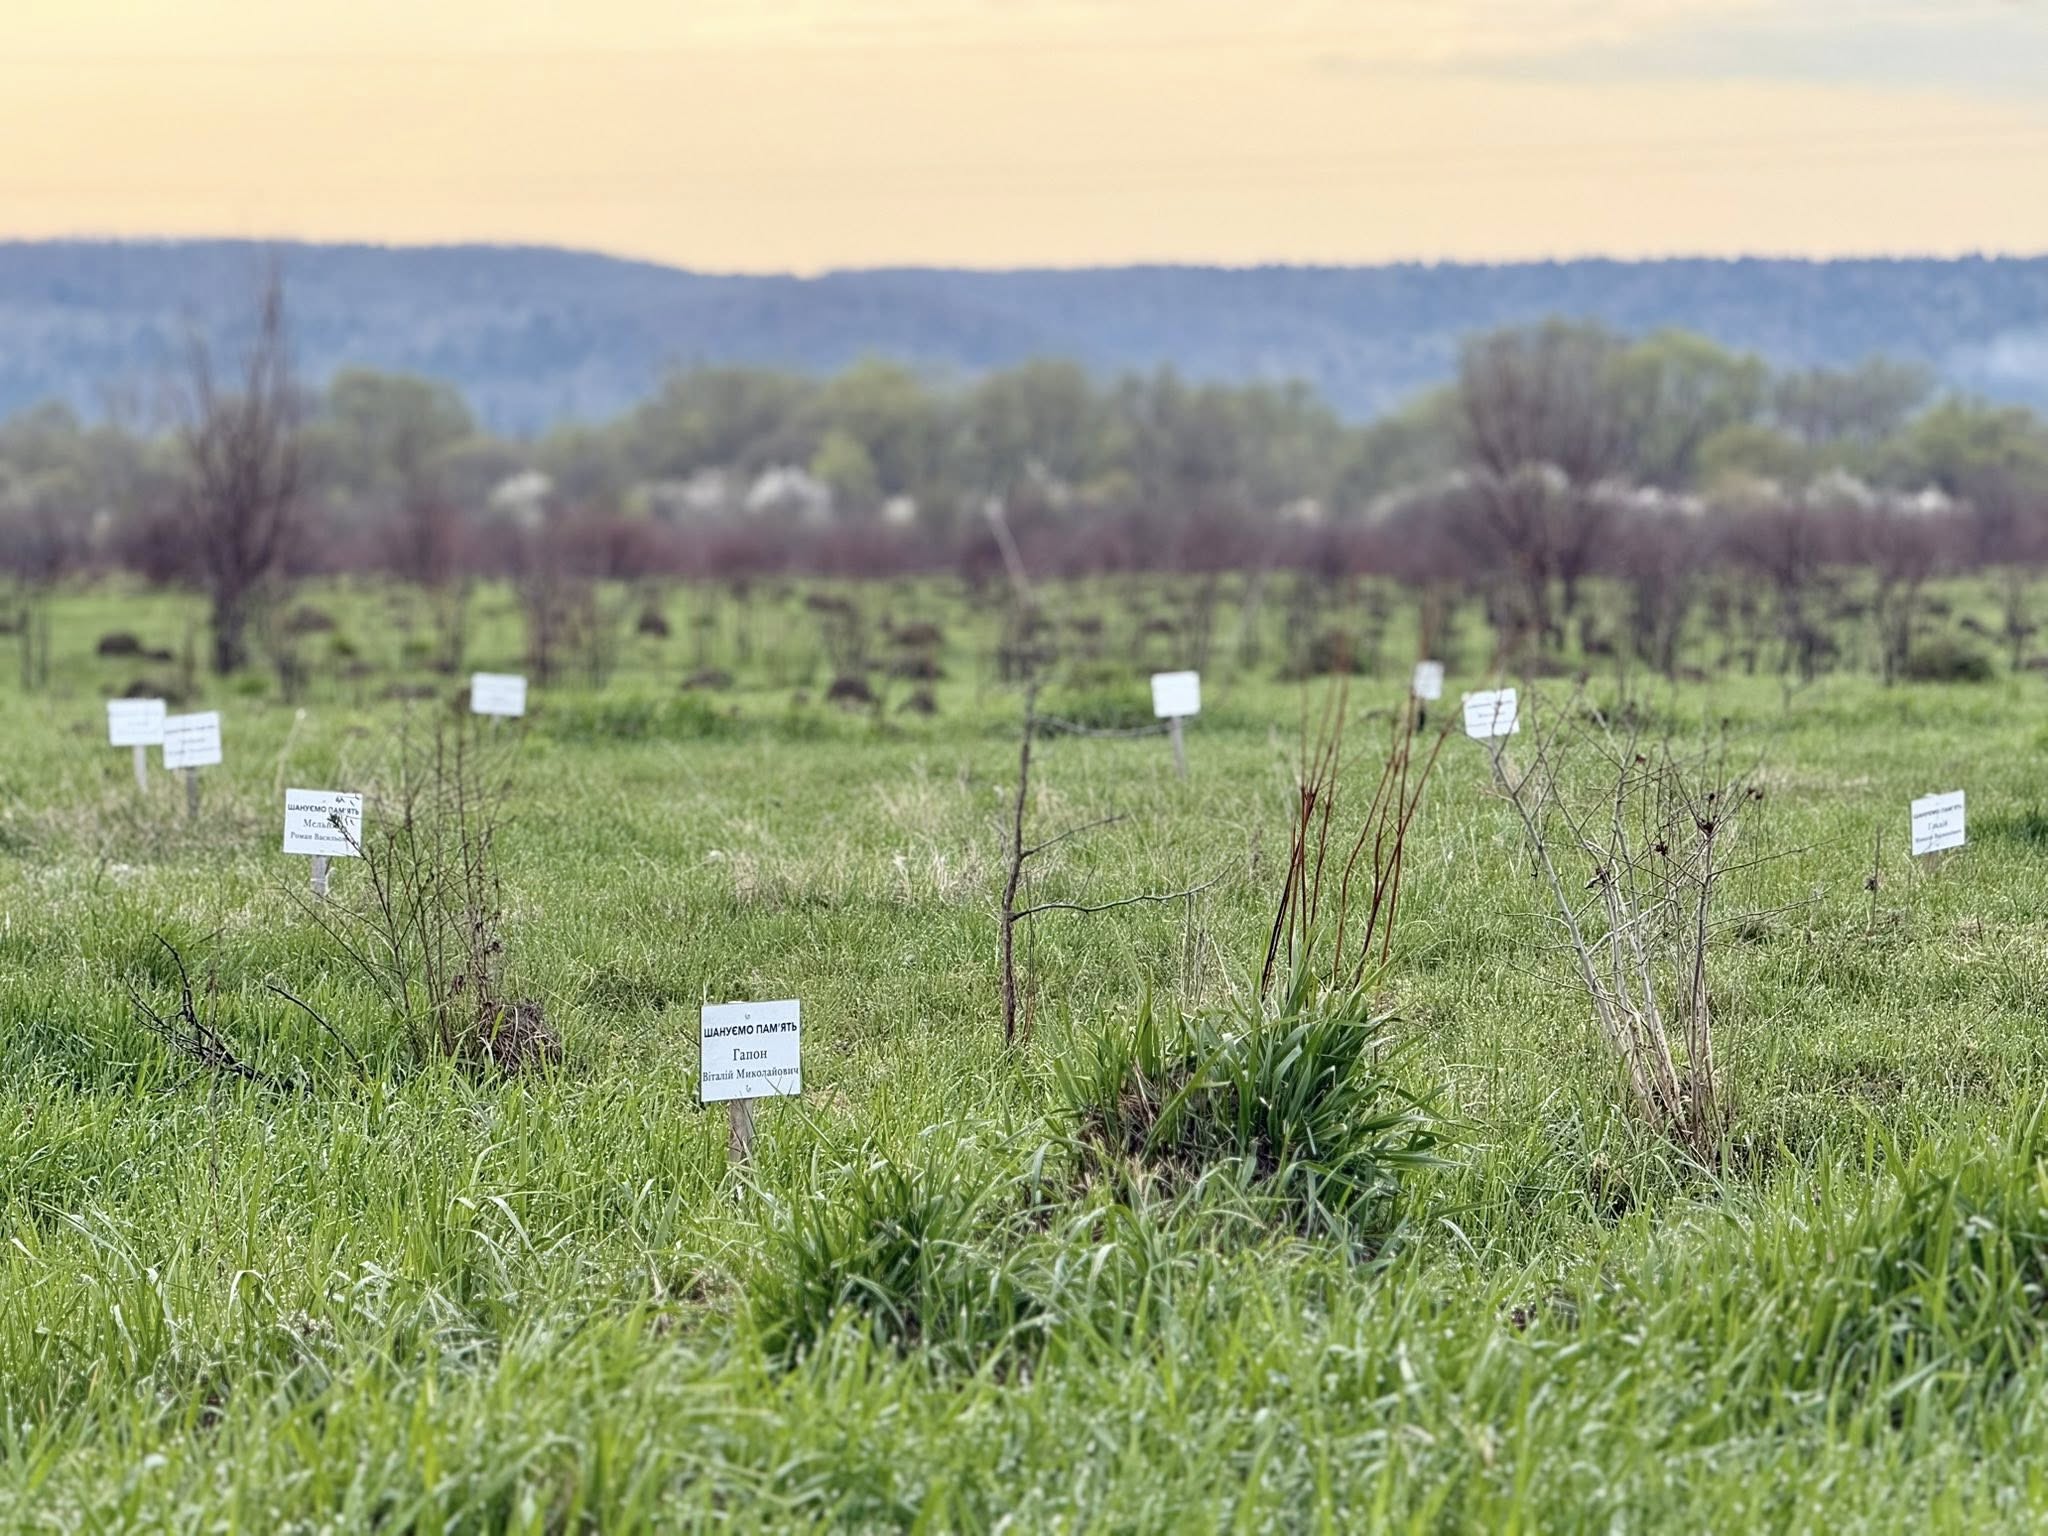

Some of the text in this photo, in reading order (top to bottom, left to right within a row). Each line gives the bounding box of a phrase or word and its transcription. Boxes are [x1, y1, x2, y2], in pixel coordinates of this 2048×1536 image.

[287, 803, 327, 813] ШАНУЄМО
[290, 831, 313, 840] Роман
[703, 1022, 798, 1038] ШАНУЄМО ПАМ'ЯТЬ
[733, 1048, 768, 1061] Гапон
[702, 1066, 799, 1082] Віталій Миколайович
